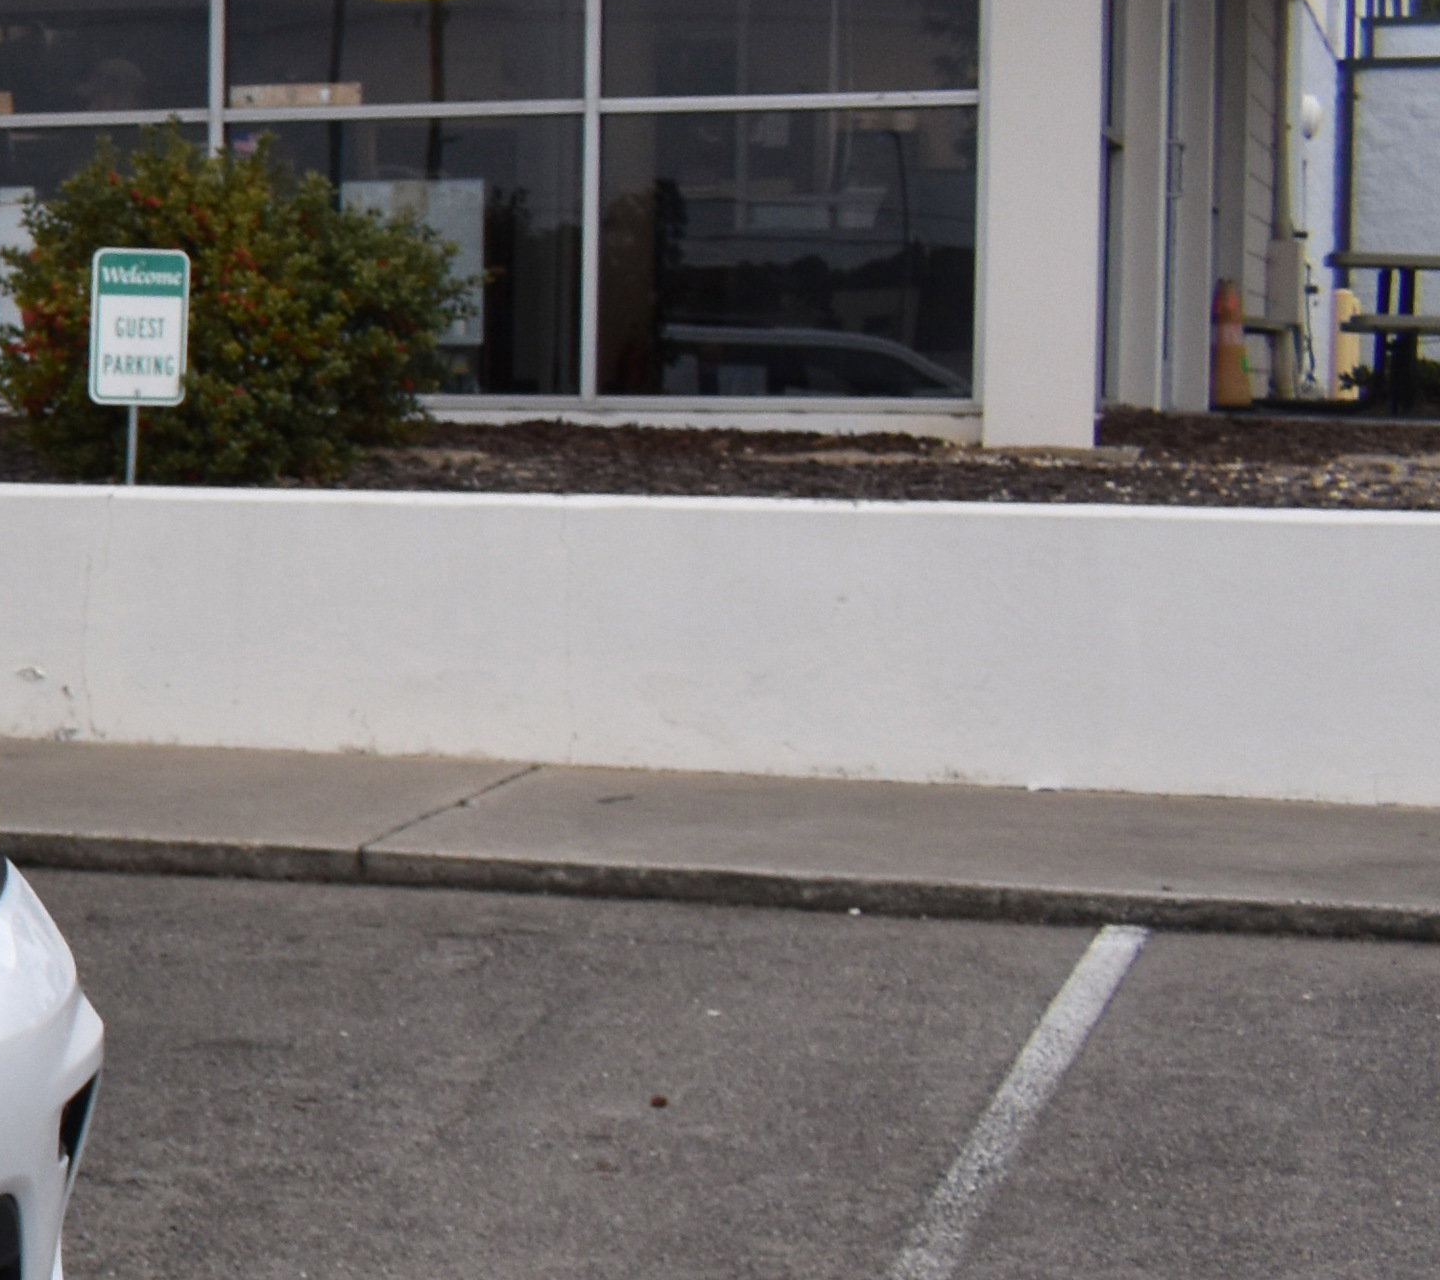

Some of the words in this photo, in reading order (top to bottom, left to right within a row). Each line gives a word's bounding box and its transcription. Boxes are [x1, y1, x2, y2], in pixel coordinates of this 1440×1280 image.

[101, 264, 183, 286] Welcome
[115, 317, 165, 338] GUEST
[103, 354, 175, 376] PARKING
